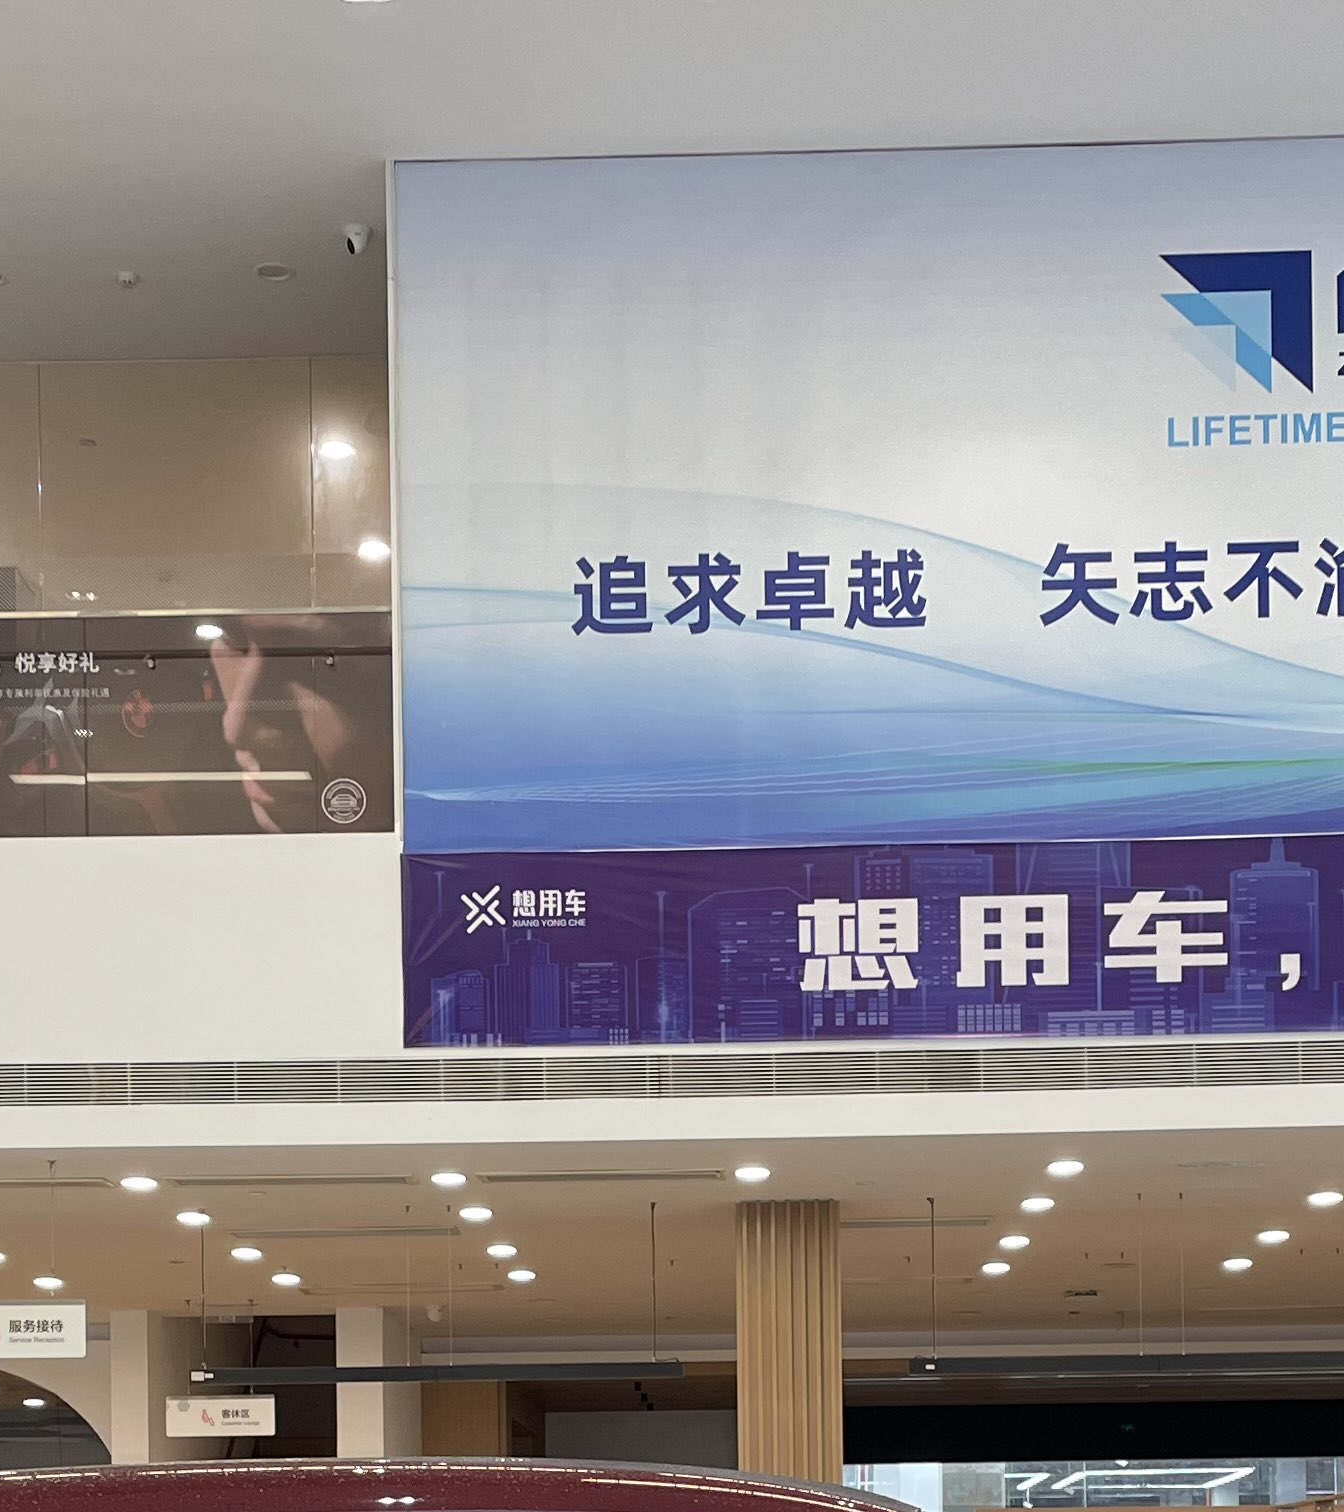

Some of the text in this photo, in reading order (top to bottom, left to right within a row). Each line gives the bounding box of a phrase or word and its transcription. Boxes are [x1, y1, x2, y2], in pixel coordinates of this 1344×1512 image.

[571, 549, 928, 637] 追求卓越
[512, 889, 586, 917] 想用车
[512, 918, 586, 927] XIANG YONG CHE
[9, 1320, 63, 1333] 服务接待
